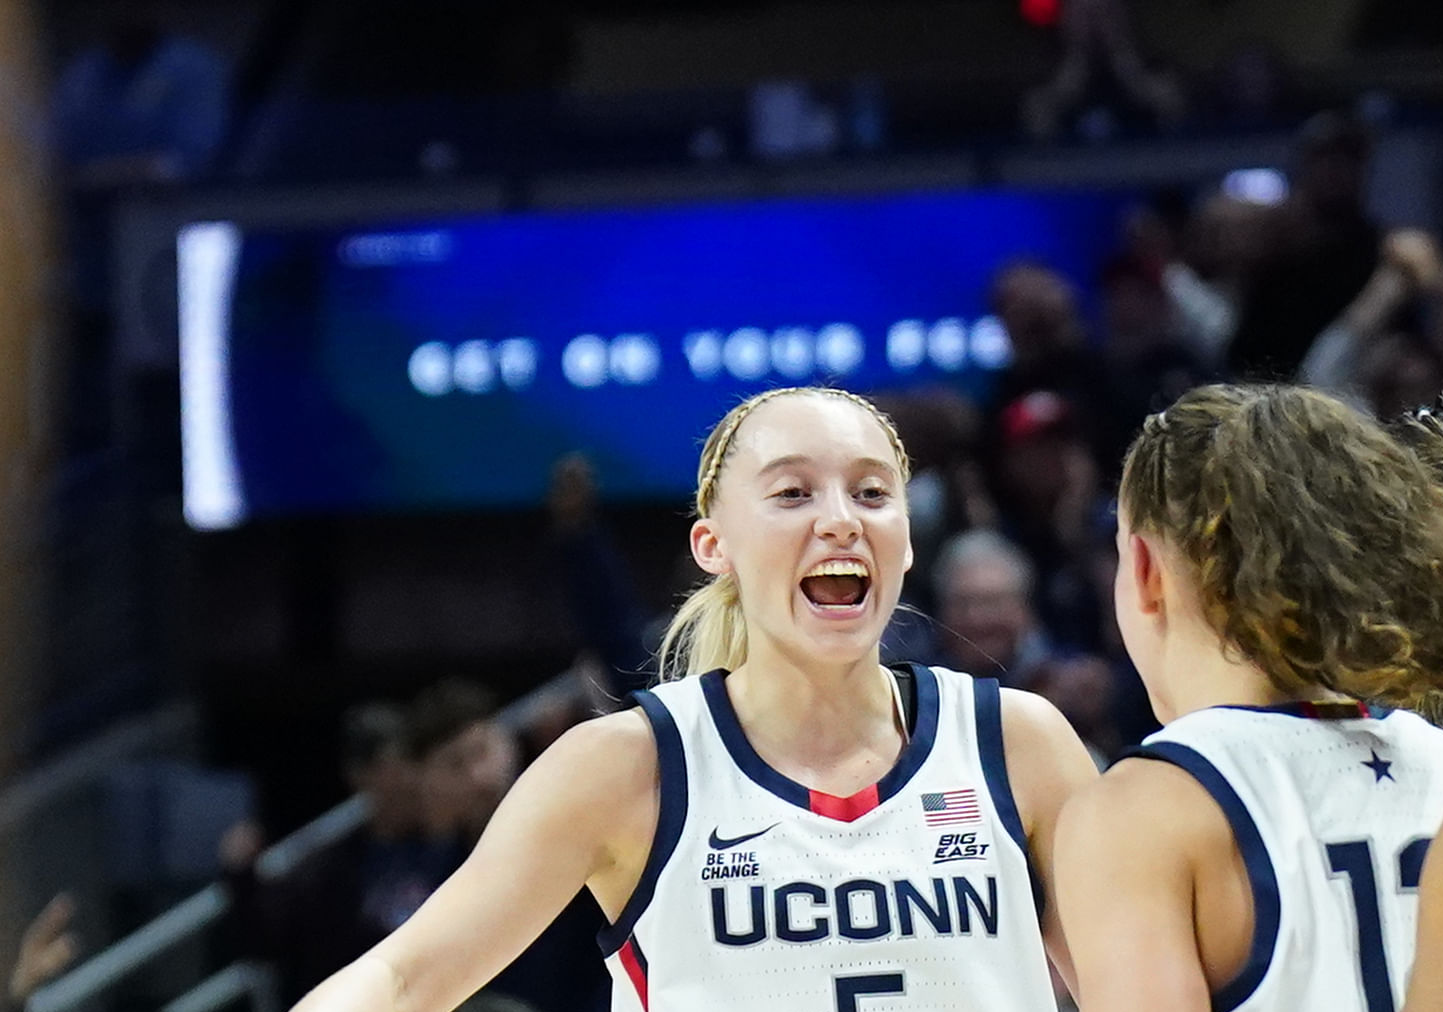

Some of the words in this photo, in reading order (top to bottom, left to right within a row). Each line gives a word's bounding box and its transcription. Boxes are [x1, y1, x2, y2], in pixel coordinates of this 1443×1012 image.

[408, 340, 538, 396] GET
[562, 333, 661, 388] ON
[683, 324, 865, 381] YOUR
[939, 832, 977, 846] BIG
[706, 854, 725, 865] BE
[731, 852, 757, 863] THE
[935, 844, 990, 858] EAST
[701, 863, 760, 880] CHANGE
[709, 875, 999, 946] UCONN
